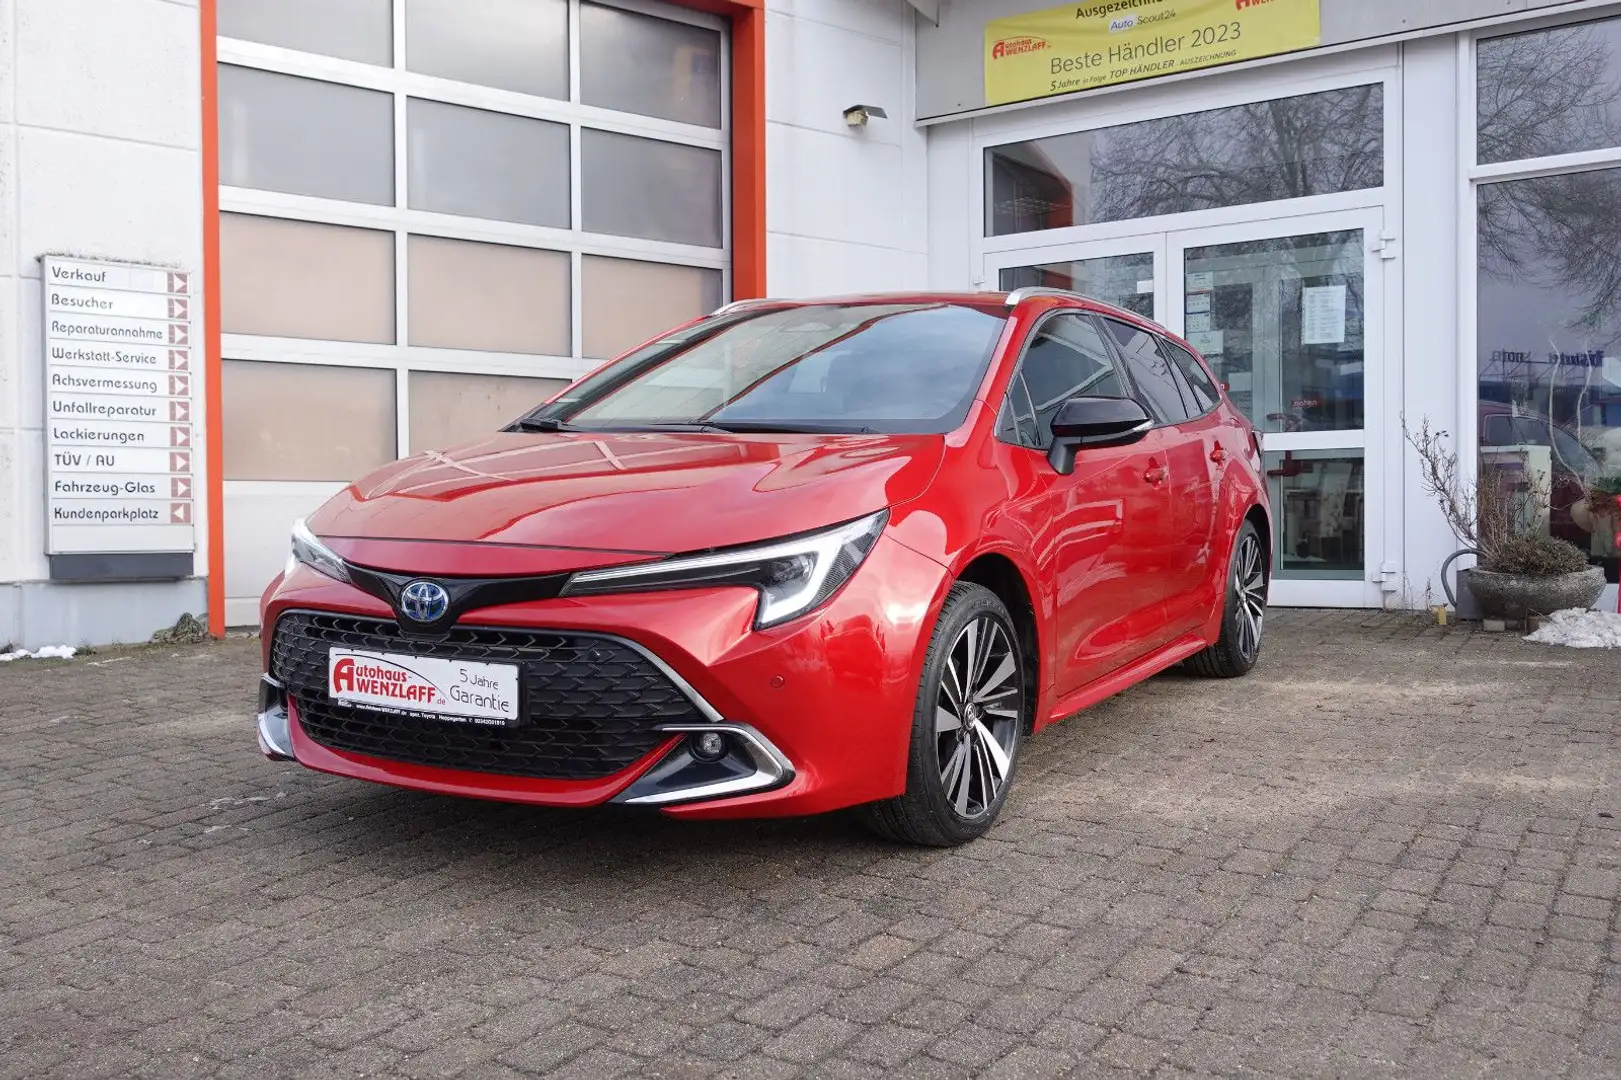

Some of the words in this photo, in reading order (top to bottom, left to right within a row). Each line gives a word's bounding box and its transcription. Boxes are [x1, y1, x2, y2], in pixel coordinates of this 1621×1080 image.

[1110, 19, 1134, 31] Auto
[1051, 52, 1102, 75] Beste
[1109, 35, 1185, 64] Händler
[1191, 22, 1241, 48] 2023
[1051, 80, 1058, 92] 5
[1057, 77, 1080, 89] Jahre
[1089, 74, 1107, 84] Folge
[1110, 68, 1129, 79] TOP
[1130, 59, 1175, 76] HÄNDLER
[1180, 49, 1237, 66] AUSZEICHNUNG
[52, 266, 106, 282] Verkauf
[51, 293, 113, 309] Besucher
[51, 320, 163, 339] Reparaturannahme
[52, 347, 157, 364] Werkstatt-Service
[52, 373, 157, 393] Achsvermessung
[52, 401, 157, 417] Unfallreparatur
[53, 428, 144, 444] Lackierungen
[54, 451, 81, 466] TÜV
[86, 455, 91, 466] /
[96, 455, 115, 466] AU
[54, 480, 155, 495] Fahrzeug-Glas
[54, 508, 159, 522] Kundenparkplatz
[460, 668, 469, 682] 5
[470, 674, 499, 690] Jahre
[356, 678, 436, 704] WENZLAFF
[450, 685, 510, 713] Garantie
